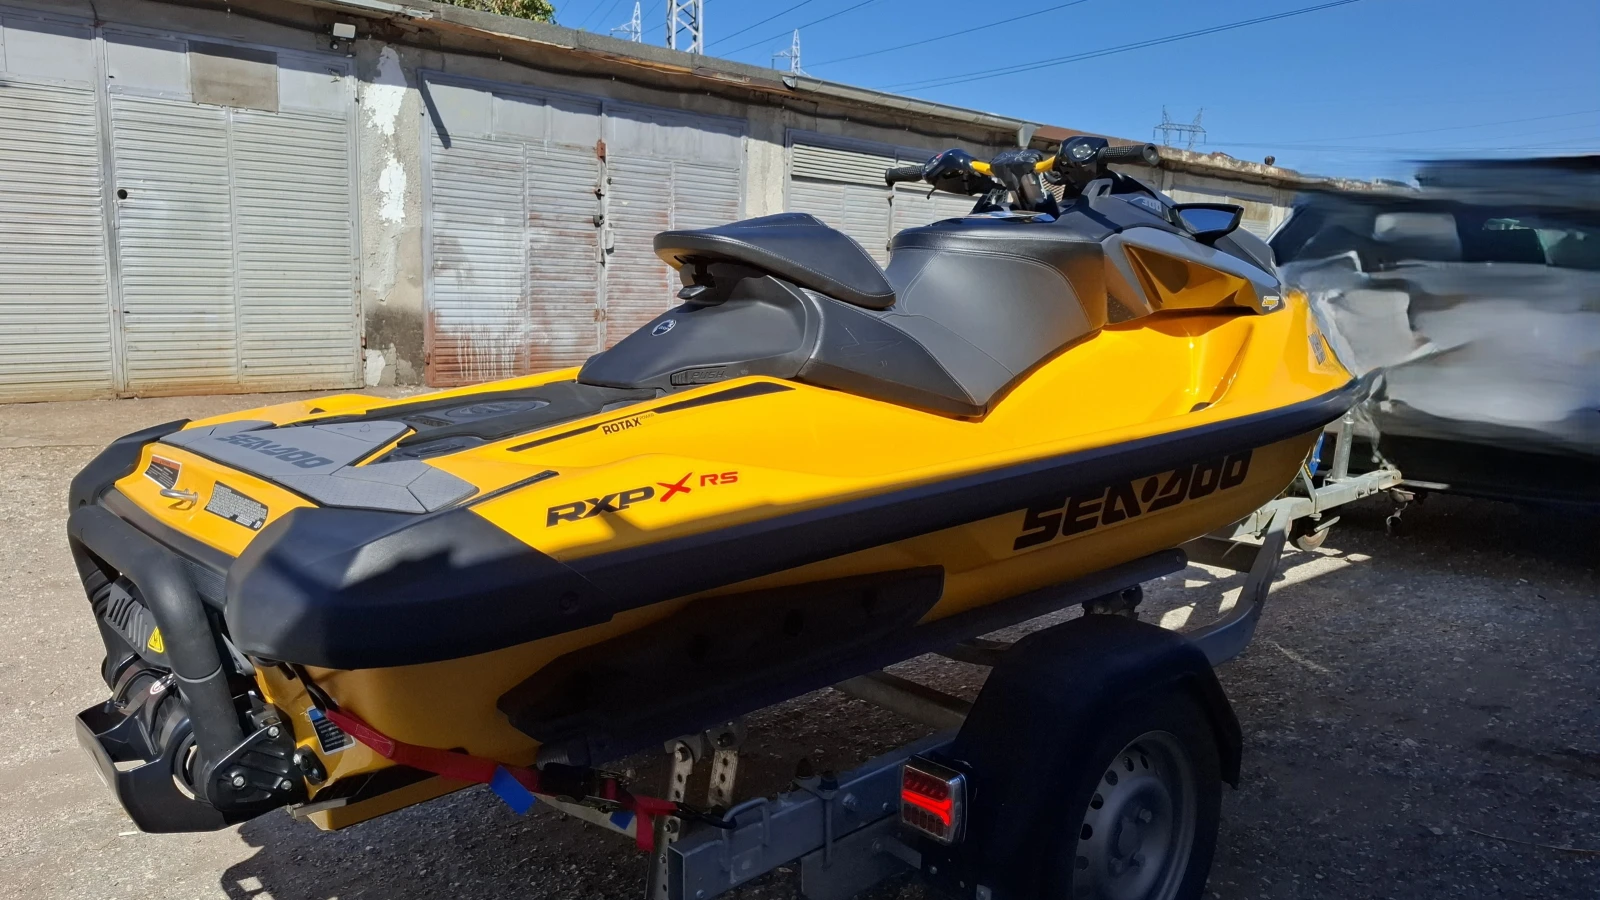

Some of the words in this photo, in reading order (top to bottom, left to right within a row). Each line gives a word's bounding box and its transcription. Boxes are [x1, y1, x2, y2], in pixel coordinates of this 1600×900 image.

[1141, 199, 1162, 213] 300
[690, 370, 725, 381] PUSH
[602, 417, 642, 435] ROTAX
[546, 486, 655, 527] RXP
[700, 471, 739, 488] RS
